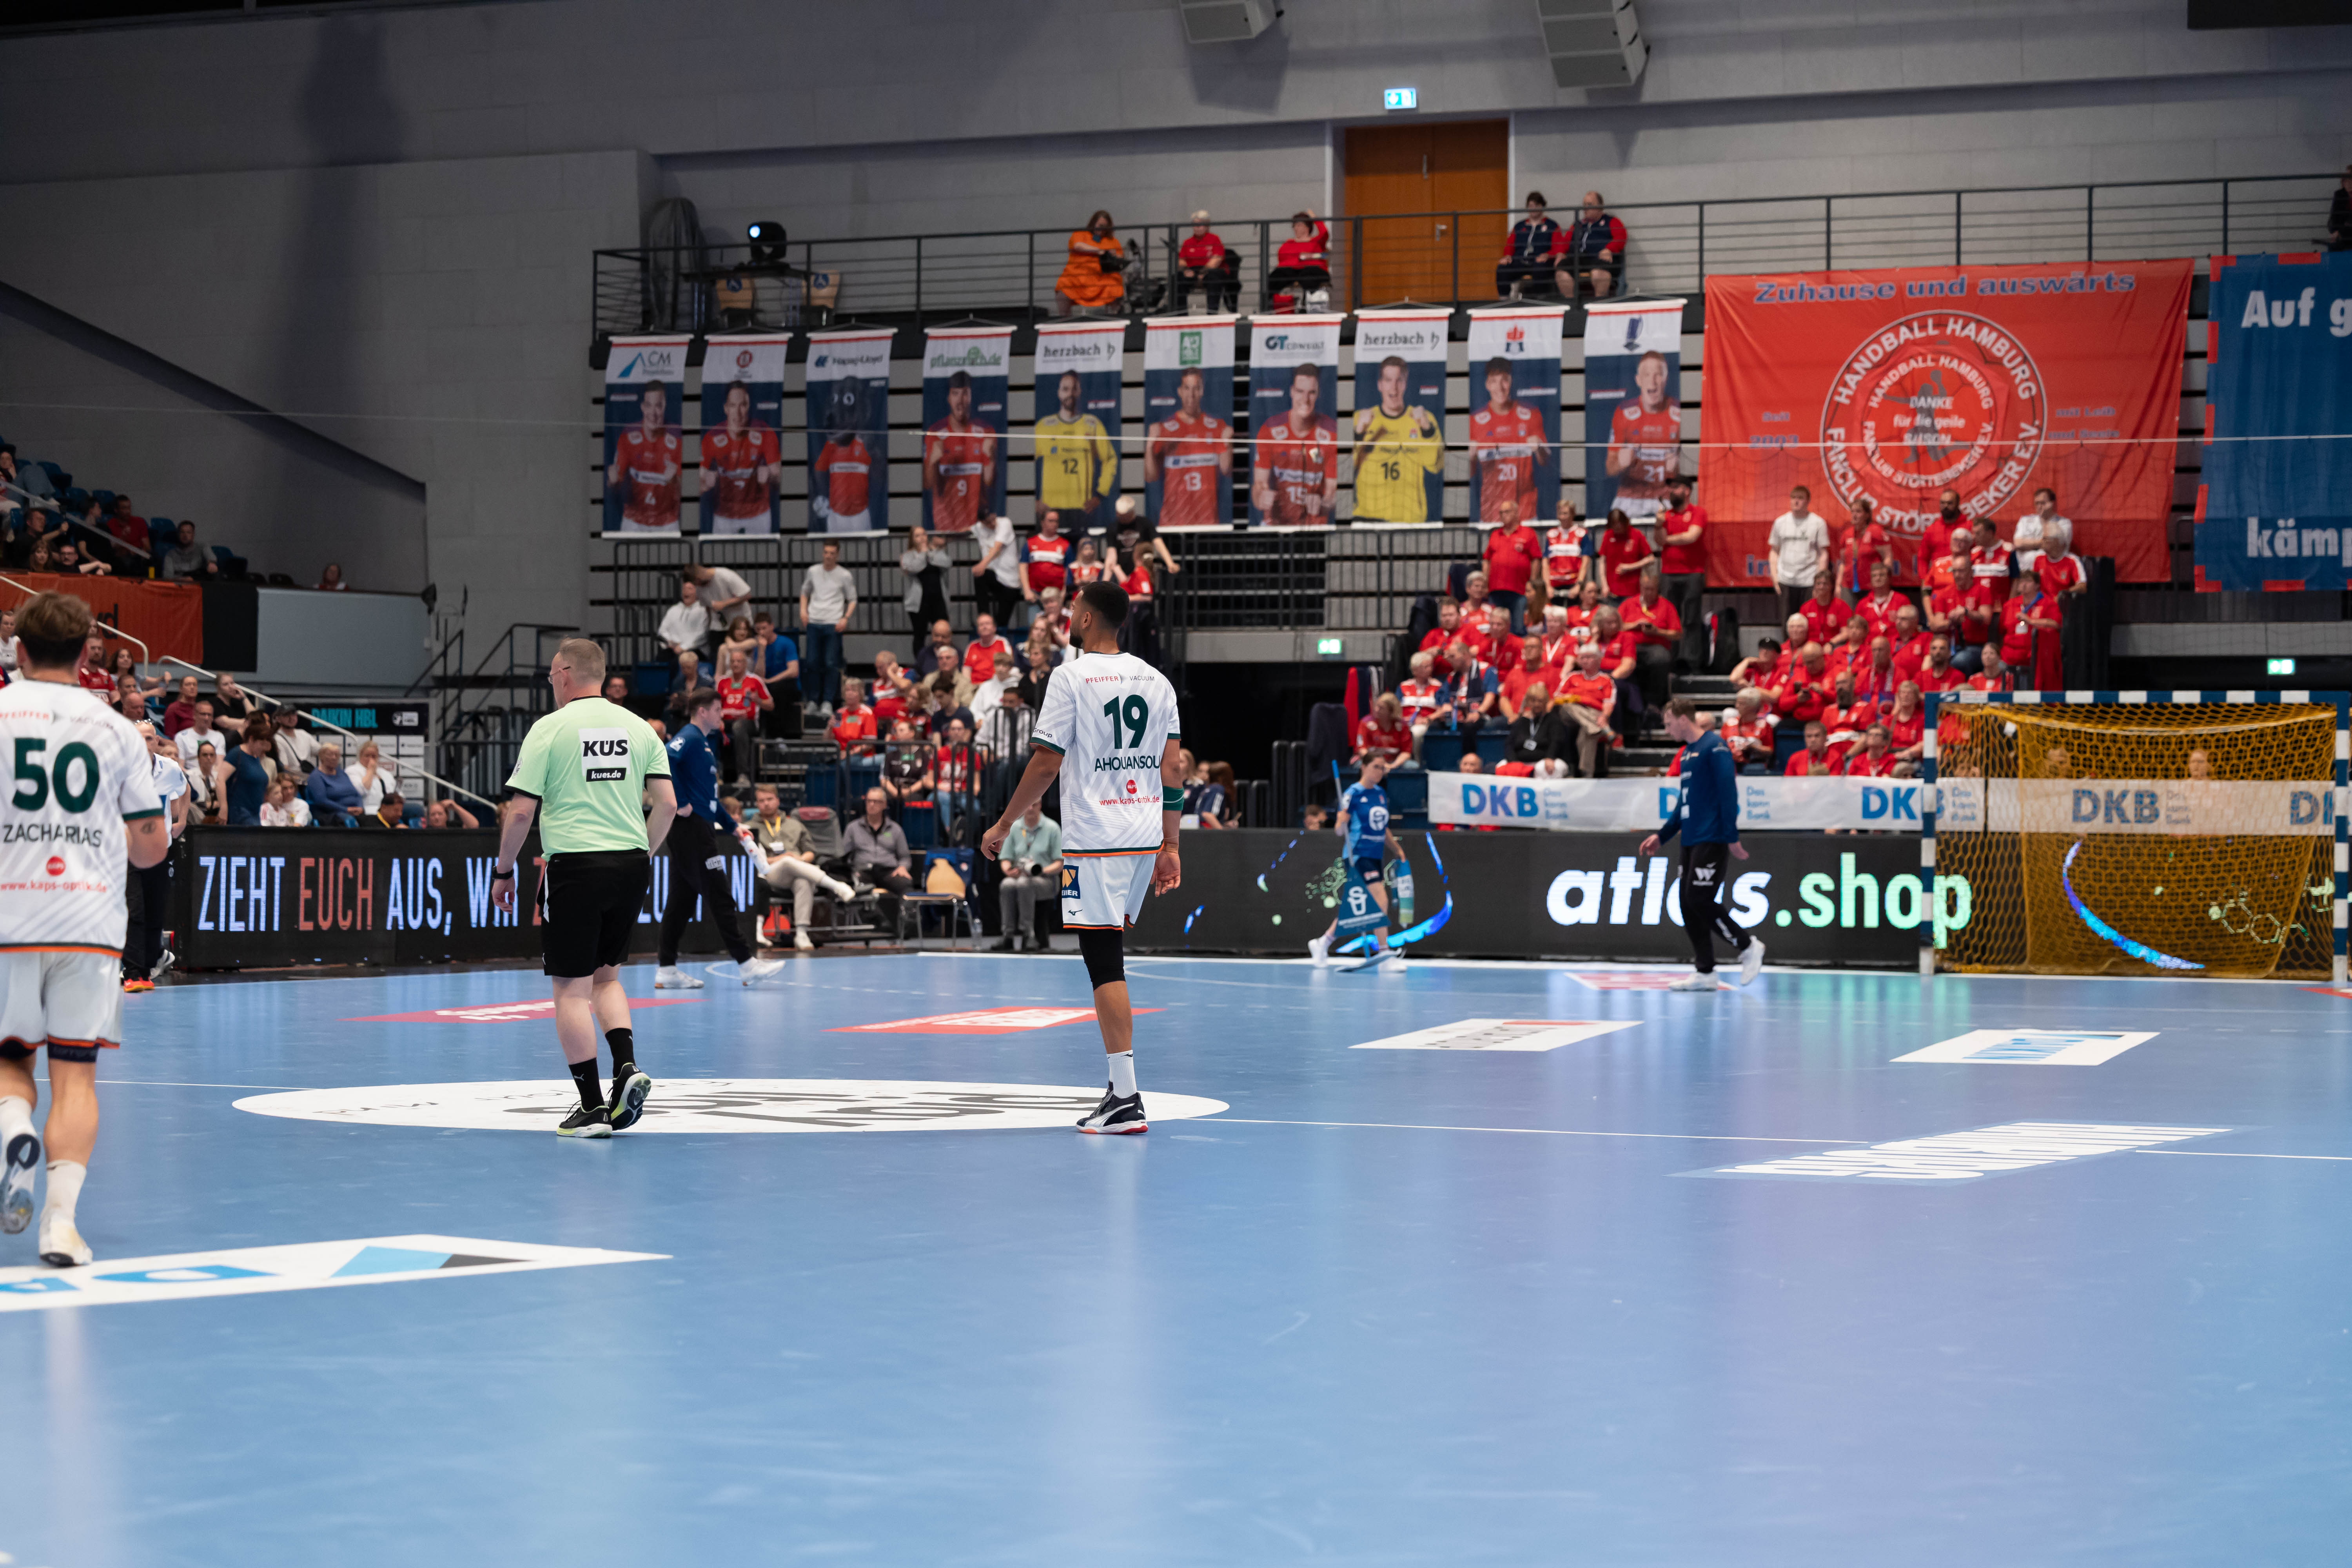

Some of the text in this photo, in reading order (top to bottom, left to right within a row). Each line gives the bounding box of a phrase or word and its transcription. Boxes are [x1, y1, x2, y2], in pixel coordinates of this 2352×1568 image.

[1753, 270, 2136, 304] Zuhause und auswärts
[2241, 286, 2315, 328] Auf
[1364, 332, 1424, 345] herzbach
[1044, 342, 1101, 357] herzbach
[1834, 318, 2037, 404] HANDBALL HAMBURG
[1869, 354, 1994, 409] HANDBALL HAMBURG
[1909, 396, 1954, 409] DANKE
[1893, 414, 1912, 427] für
[1934, 414, 1965, 430] geile
[1062, 458, 1078, 474] 12
[1381, 461, 1401, 480] 16
[1497, 464, 1517, 481] 20
[1643, 465, 1665, 482] 21
[956, 479, 967, 496] 9
[1184, 472, 1202, 491] 13
[1876, 460, 2025, 532] STÖRBEKER
[312, 708, 352, 728] DAIKIN
[354, 708, 378, 728] HBL
[1103, 694, 1149, 750] 19
[1033, 728, 1053, 738] Group
[583, 739, 628, 757] KÜS
[1094, 755, 1161, 772] AHOUANSOU
[12, 737, 100, 814] 50
[591, 770, 622, 780] kues.de
[1462, 783, 1539, 817] DKB
[2072, 788, 2160, 824] DKB
[4, 823, 102, 848] ZACHARIAS
[198, 856, 285, 932] ZIEHT
[298, 858, 374, 931] EUCH
[386, 858, 452, 936] AUS,
[1546, 851, 1972, 949] atls.shop
